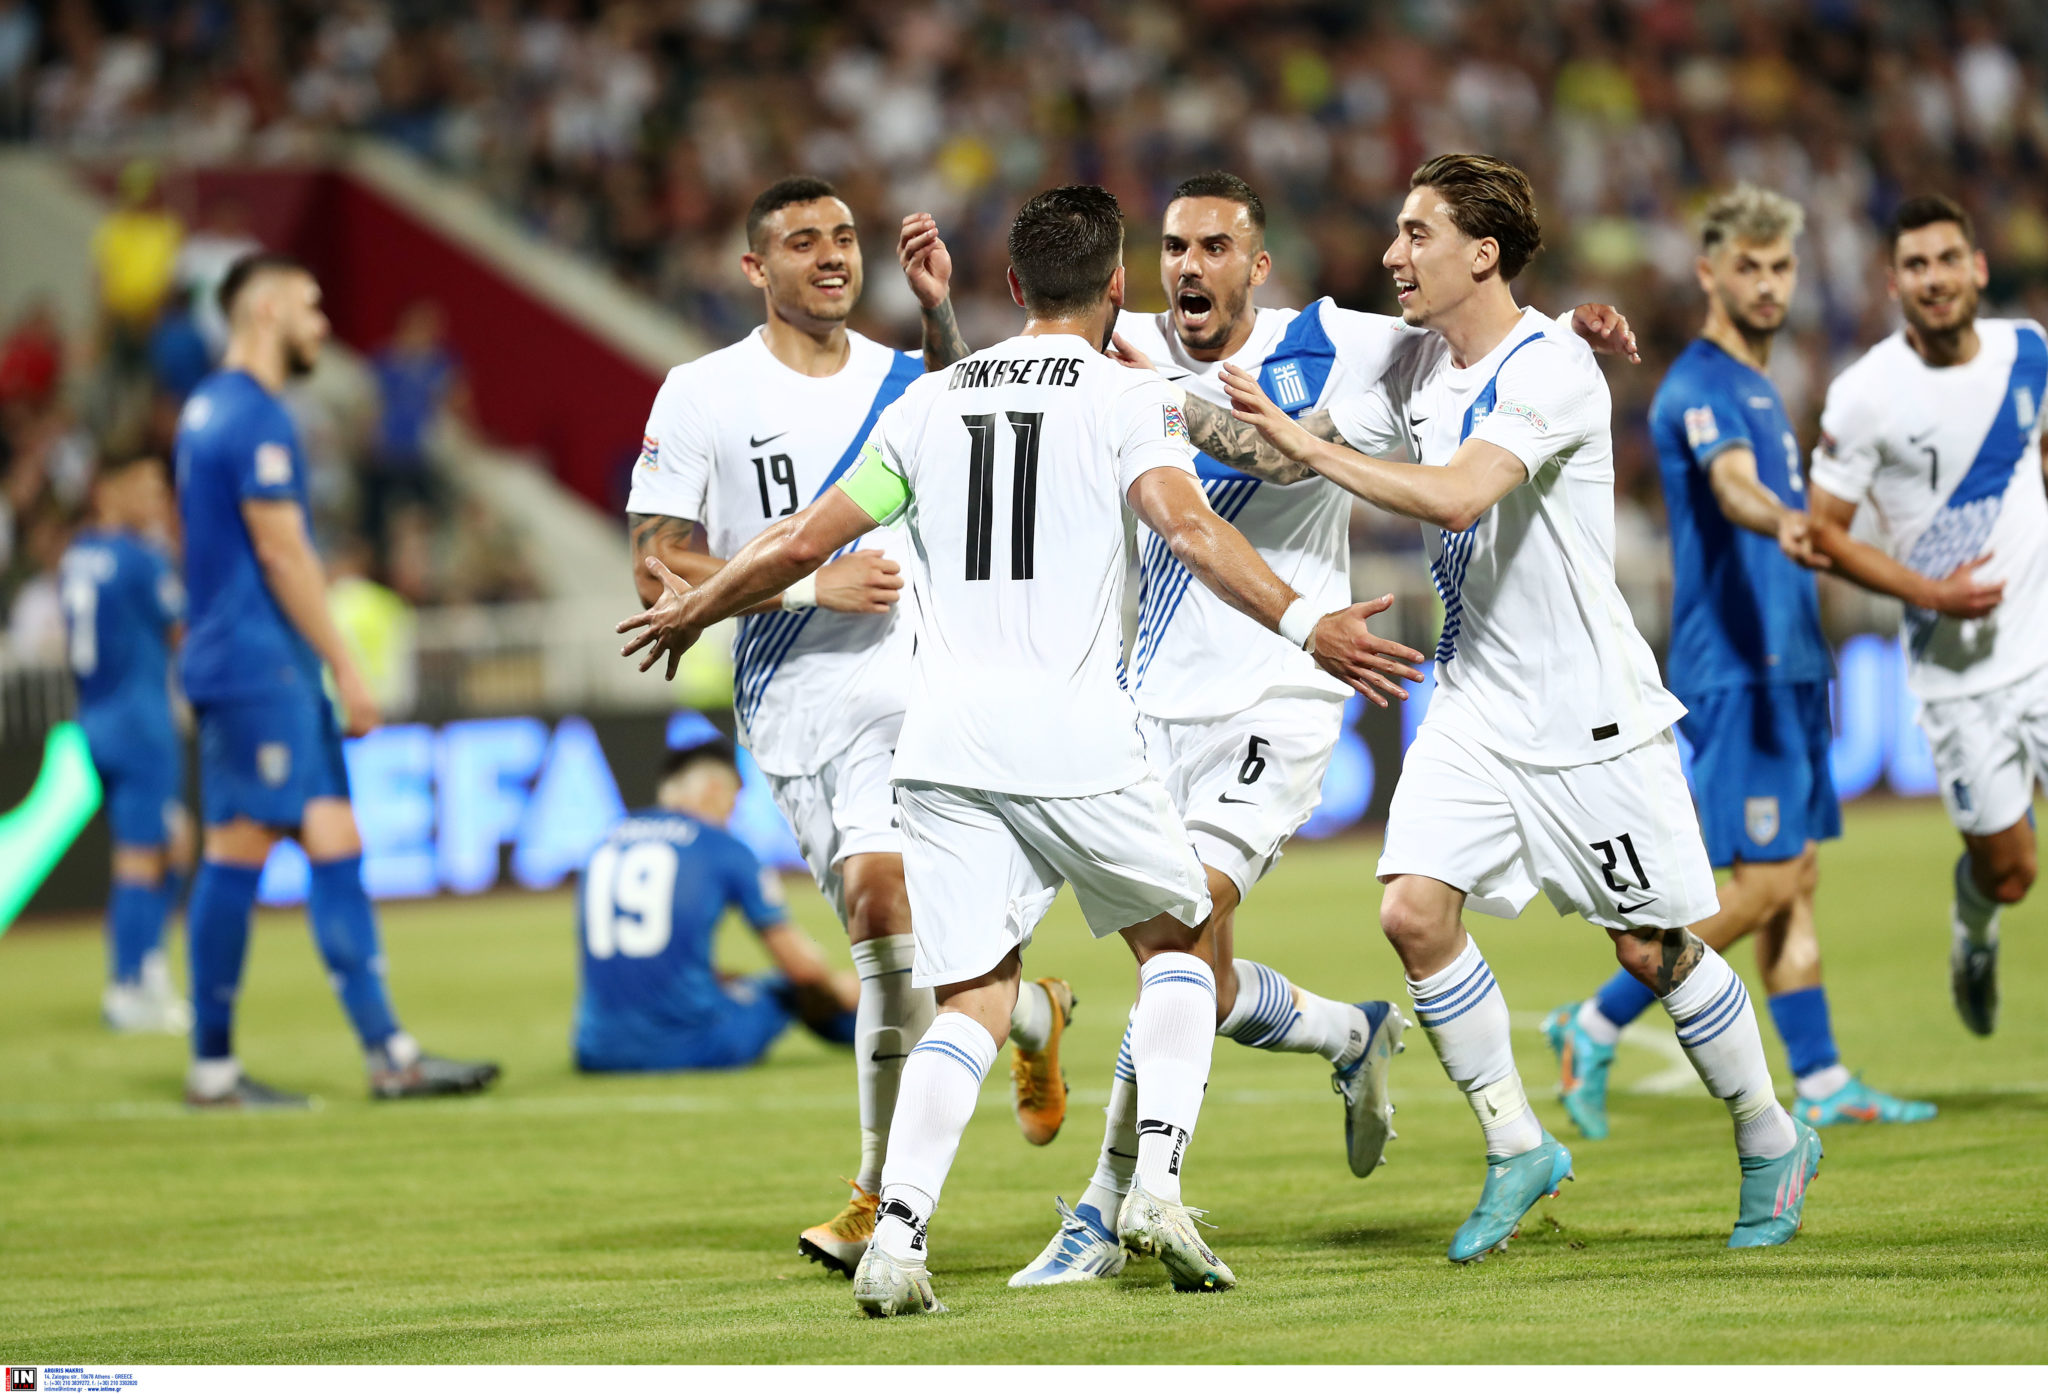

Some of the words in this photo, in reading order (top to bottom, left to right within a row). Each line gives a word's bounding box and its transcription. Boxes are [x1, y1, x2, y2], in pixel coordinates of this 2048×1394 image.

[948, 357, 1085, 391] BAKASETAS
[751, 453, 799, 519] 19
[961, 411, 1044, 581] 11
[1921, 447, 1938, 490] 7
[1238, 735, 1271, 785] 6
[1589, 832, 1651, 892] 21
[584, 840, 680, 960] 19
